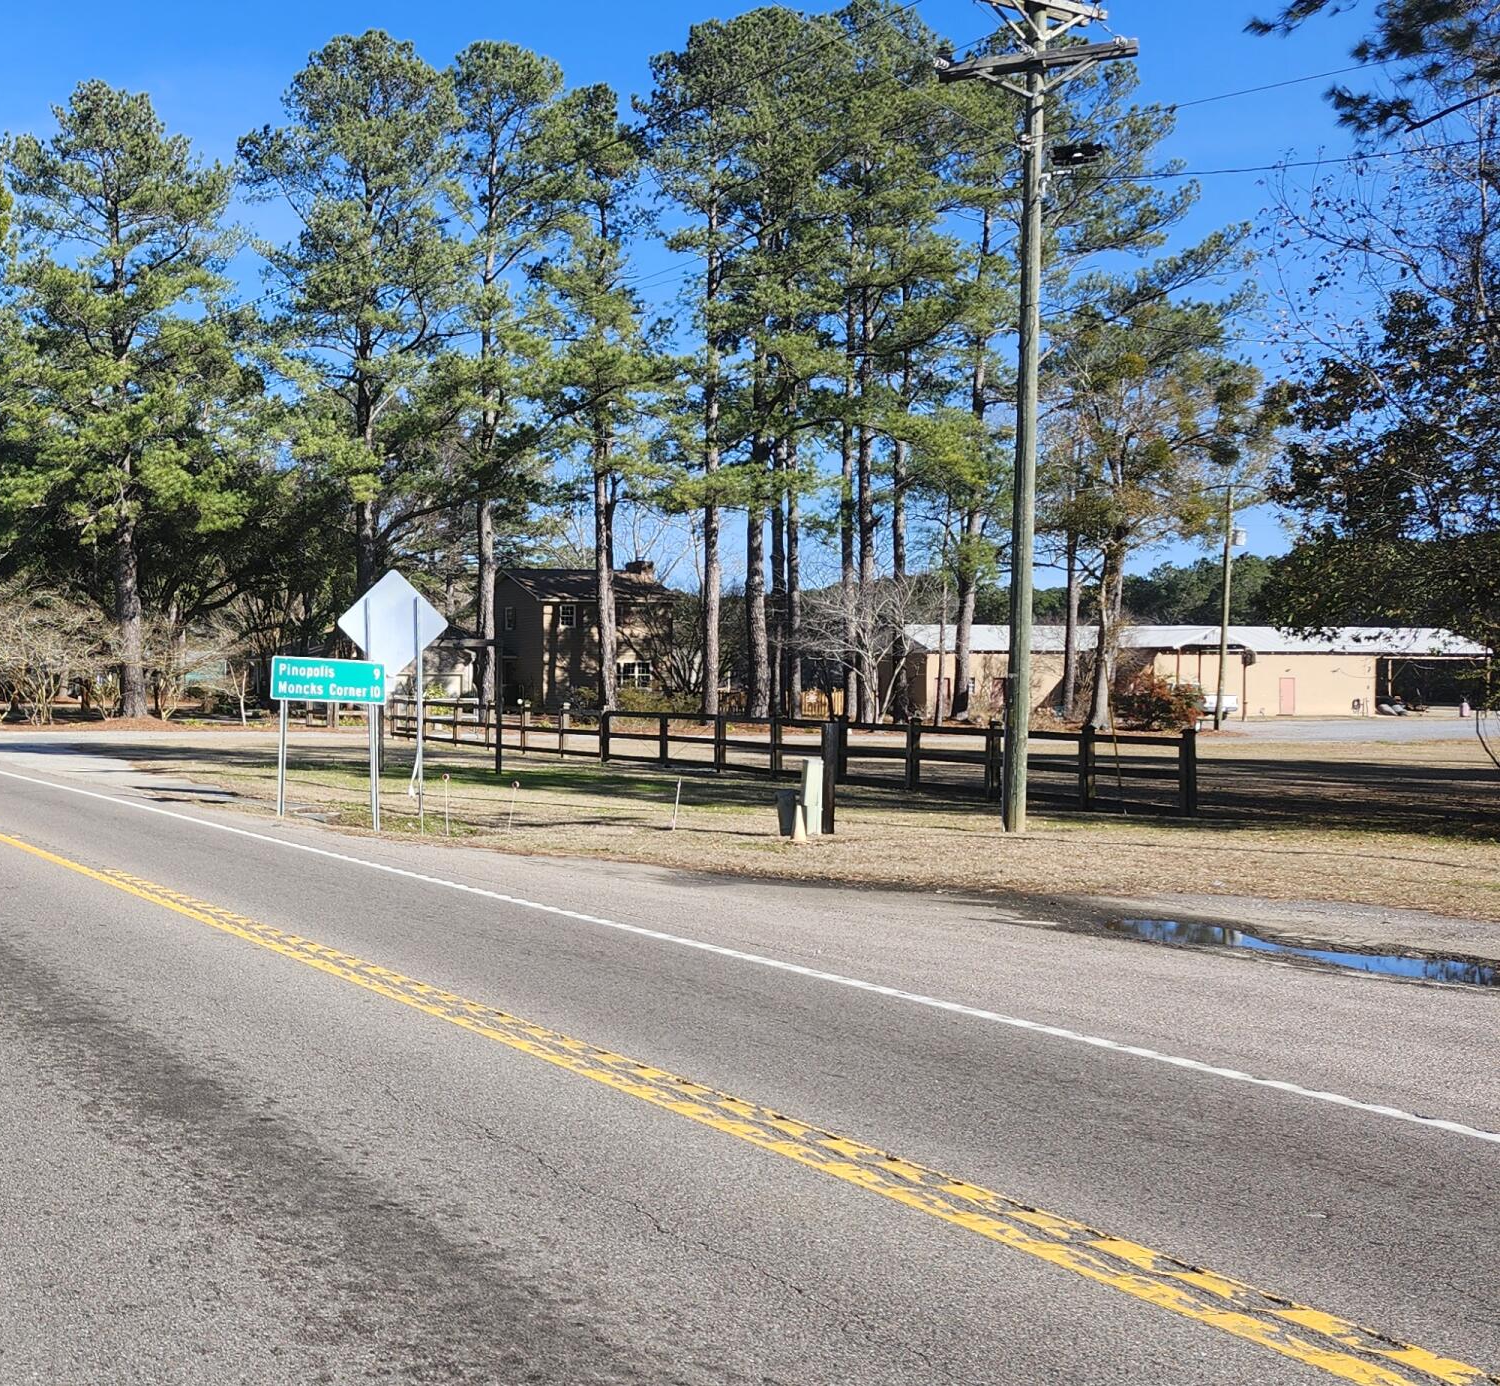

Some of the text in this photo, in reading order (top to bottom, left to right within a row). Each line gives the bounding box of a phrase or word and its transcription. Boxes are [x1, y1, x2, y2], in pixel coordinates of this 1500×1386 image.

[278, 663, 380, 681] Pinopolis 9
[278, 681, 380, 698] Moncks Corner 10
